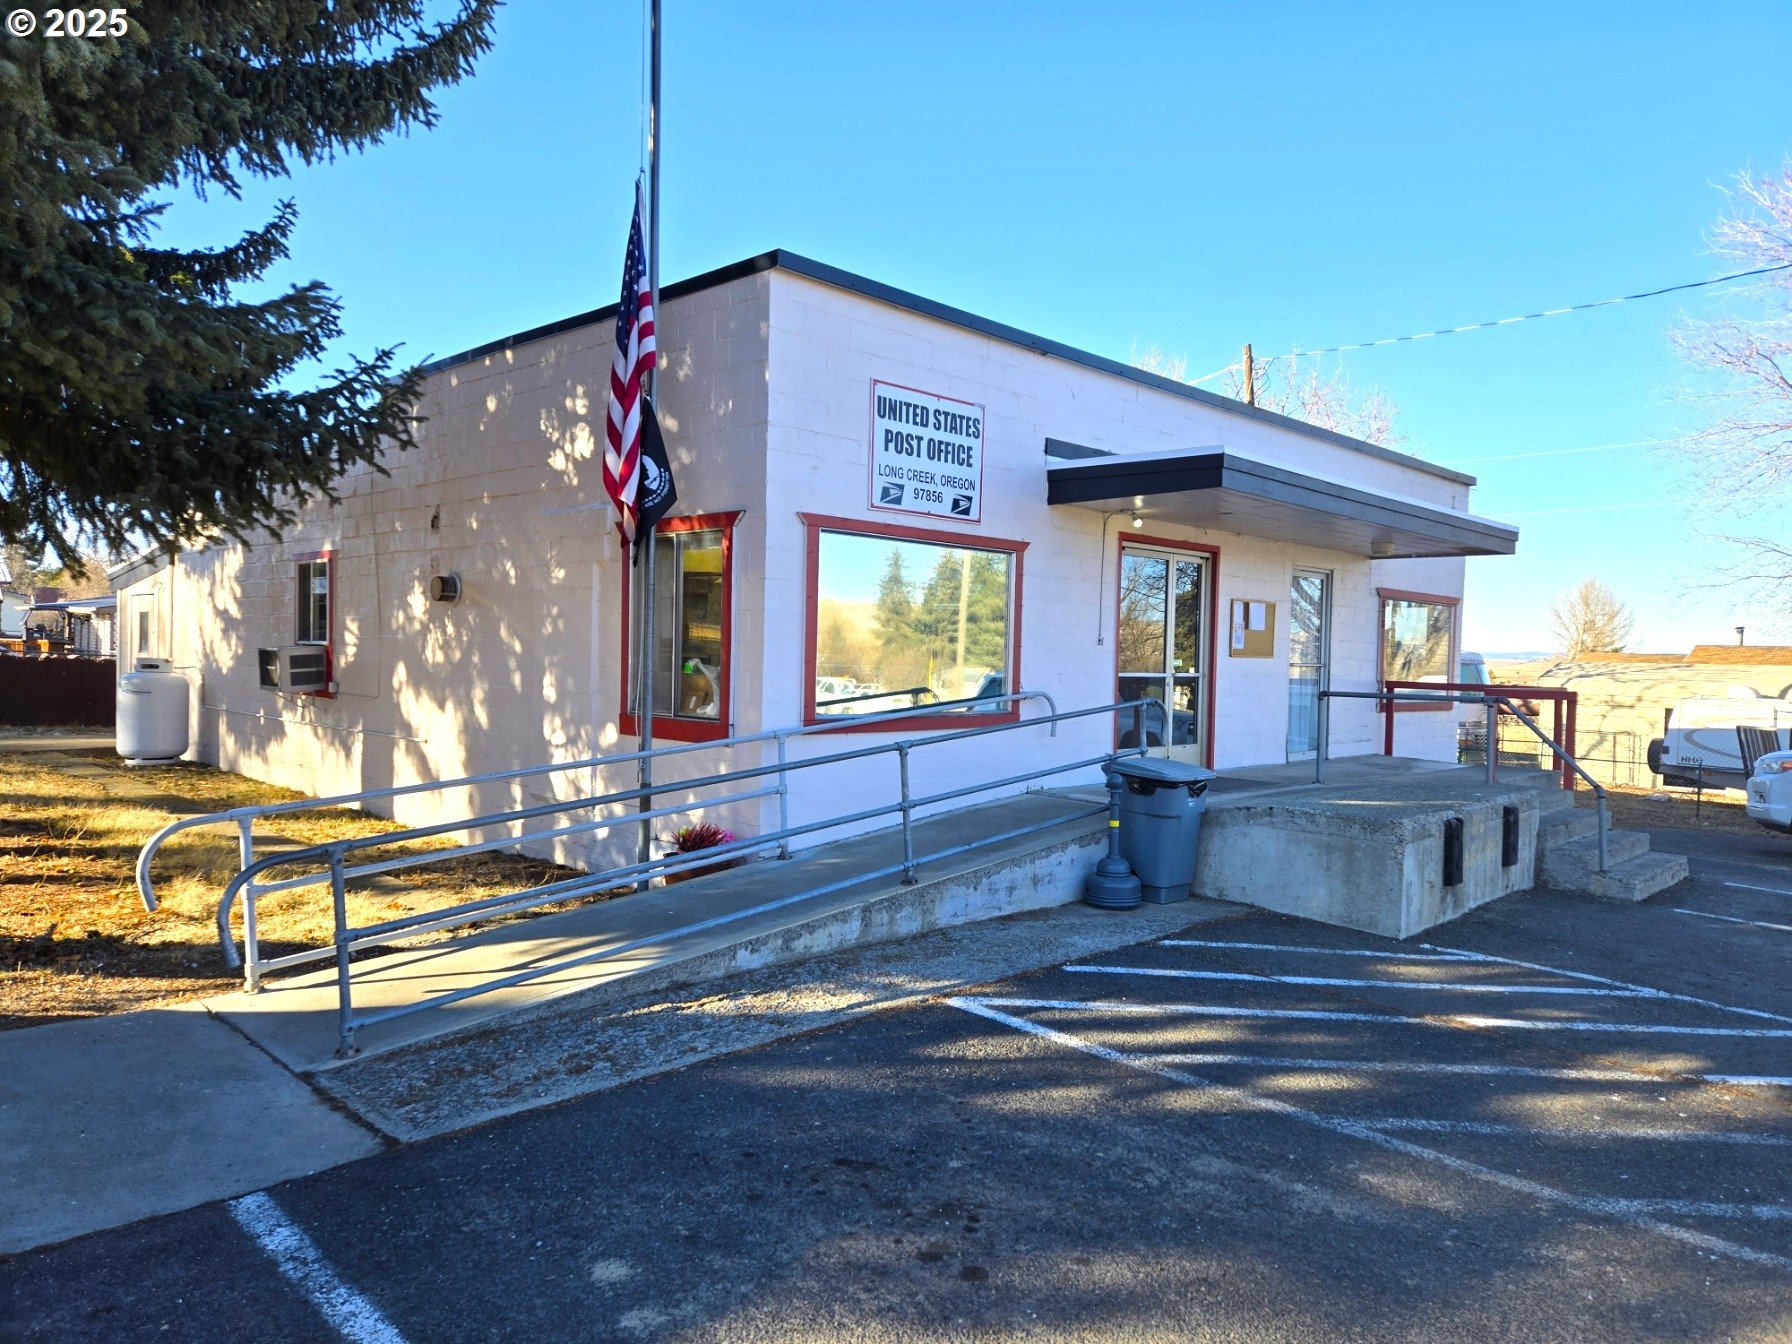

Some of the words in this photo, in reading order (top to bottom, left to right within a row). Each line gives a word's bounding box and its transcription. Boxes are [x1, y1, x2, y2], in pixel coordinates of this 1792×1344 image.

[877, 395, 930, 428] UNITED
[933, 408, 981, 439] STATES
[884, 428, 924, 458] POST
[926, 437, 973, 468] OFFICE
[878, 463, 904, 479] LONG
[906, 468, 938, 487] CREEK,
[940, 474, 976, 491] OREGON
[913, 487, 944, 504] 97856
